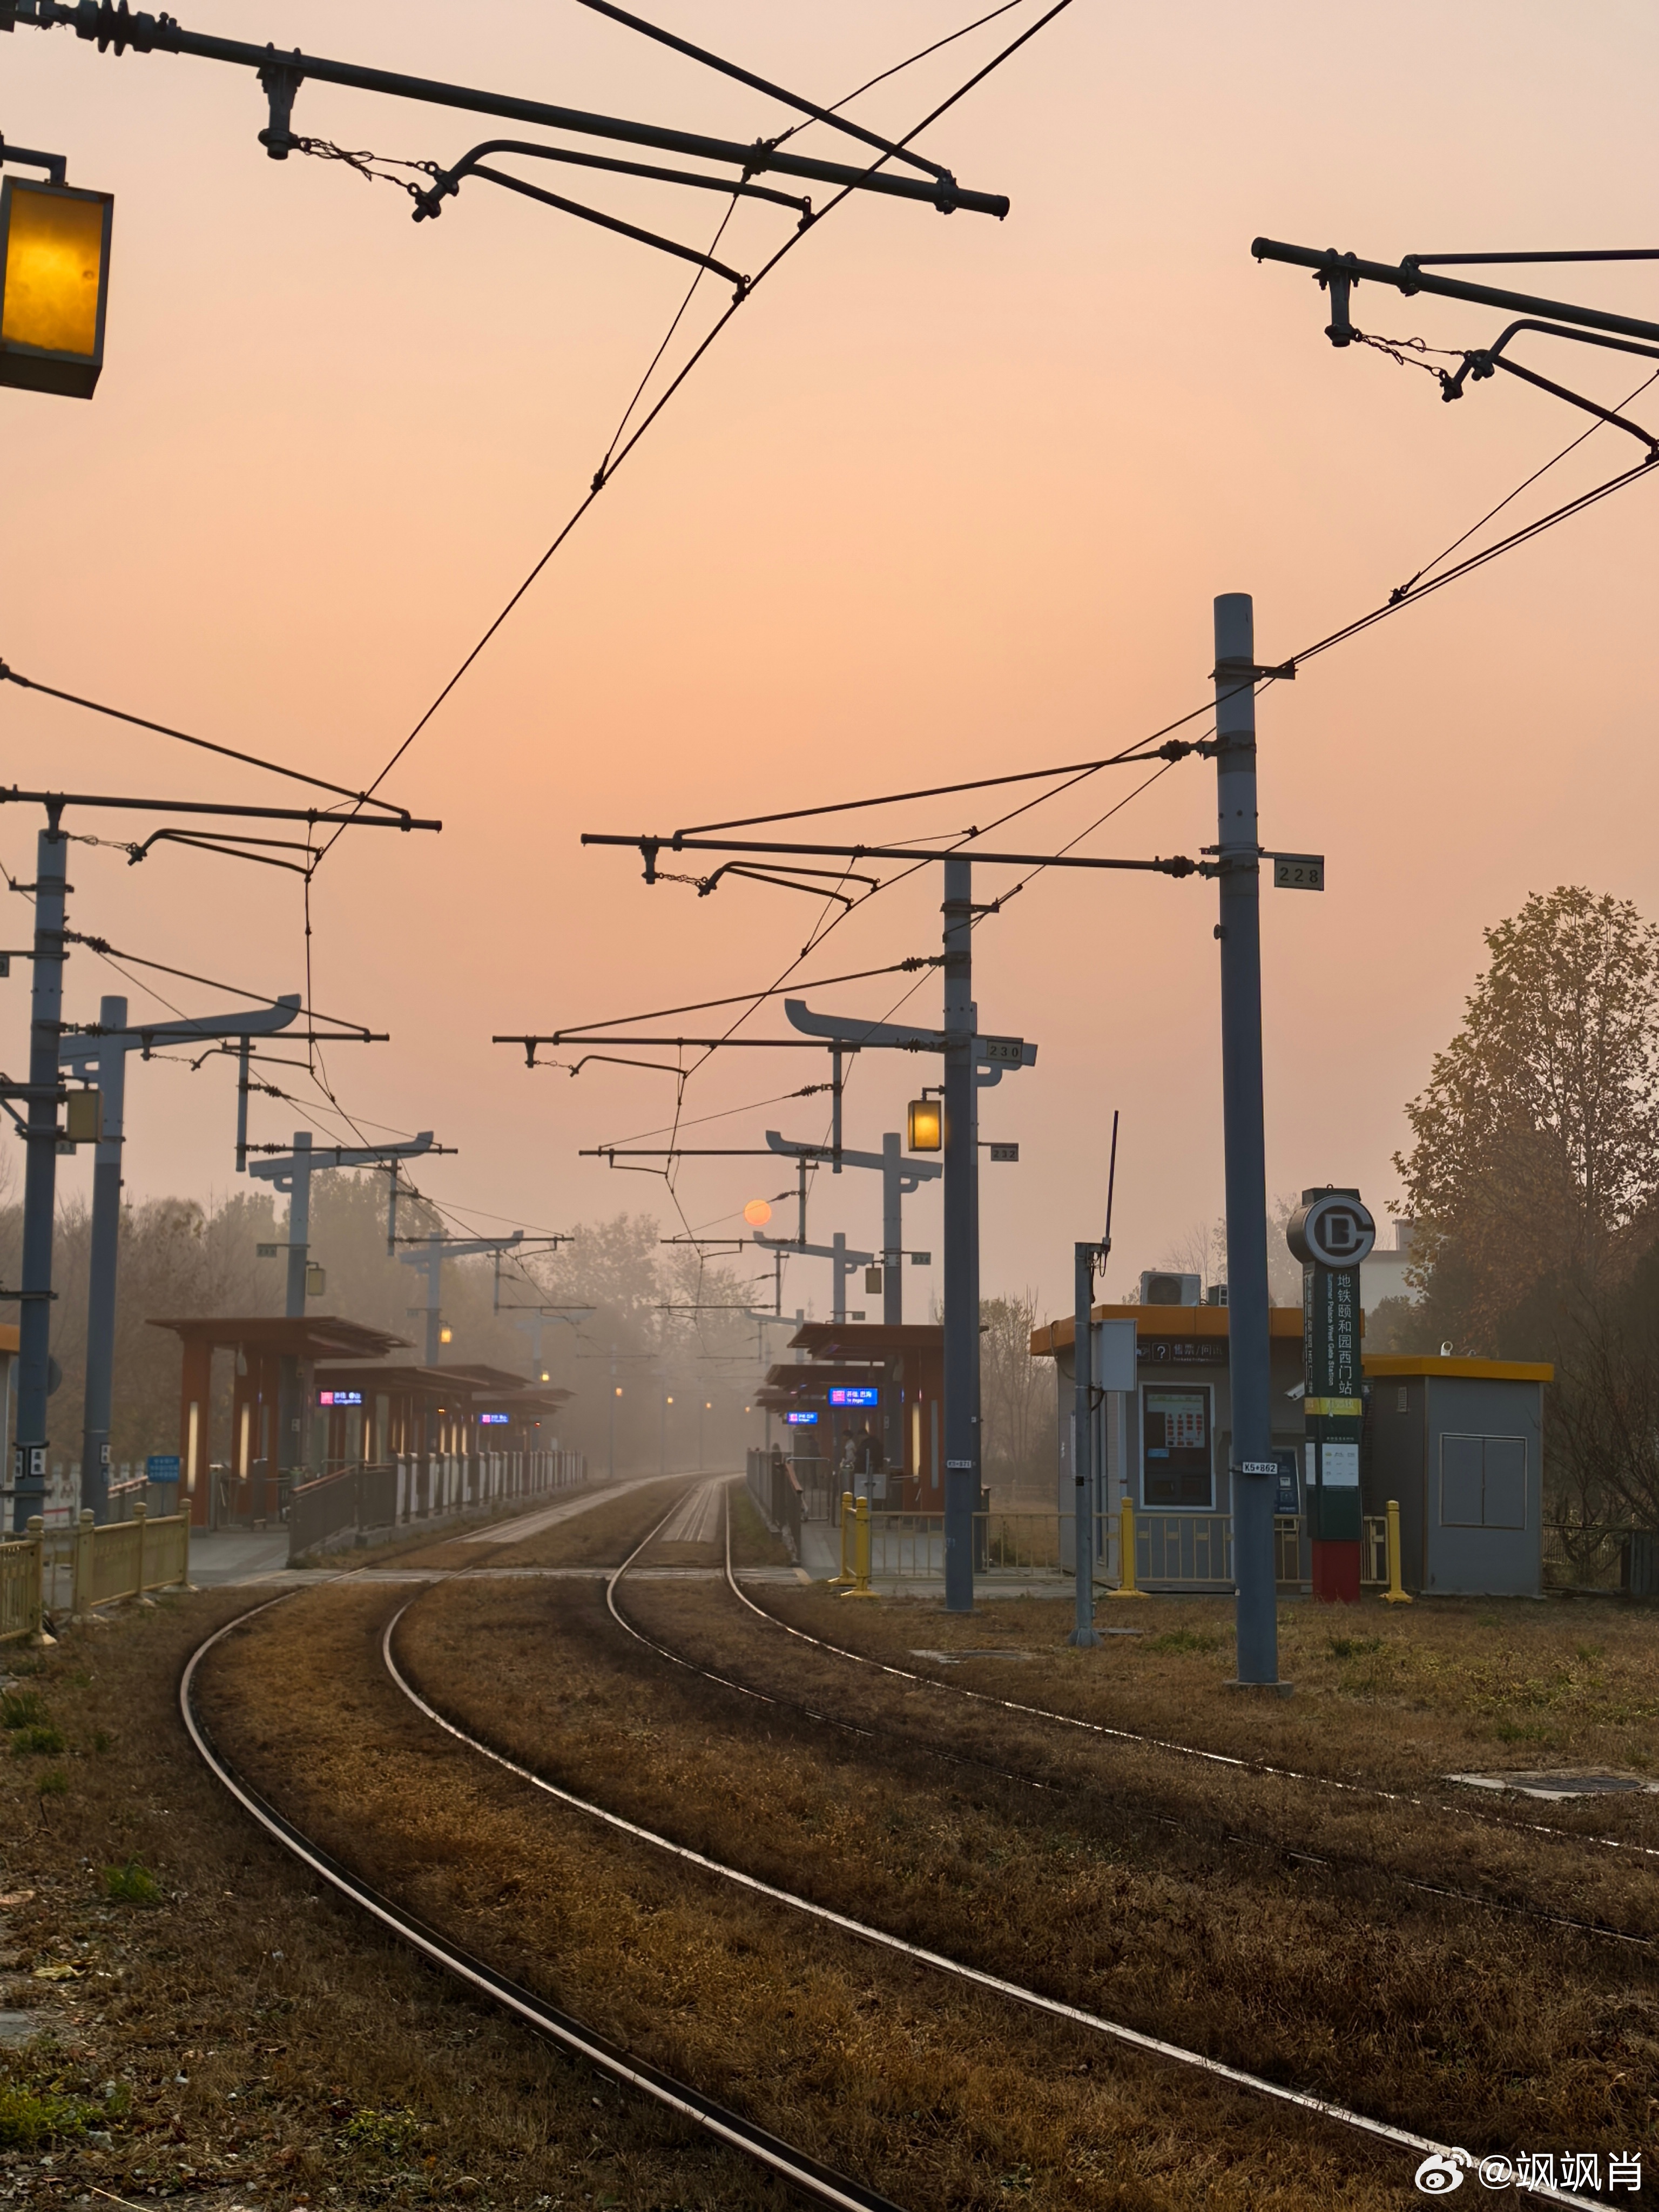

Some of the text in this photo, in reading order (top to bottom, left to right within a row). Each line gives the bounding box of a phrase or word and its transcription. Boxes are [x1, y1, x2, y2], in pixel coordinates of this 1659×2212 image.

[1279, 867, 1319, 884] 228
[989, 1045, 1019, 1058] 230
[993, 1150, 1016, 1158] 232
[1337, 1273, 1353, 1395] 地铁颐和园西门站
